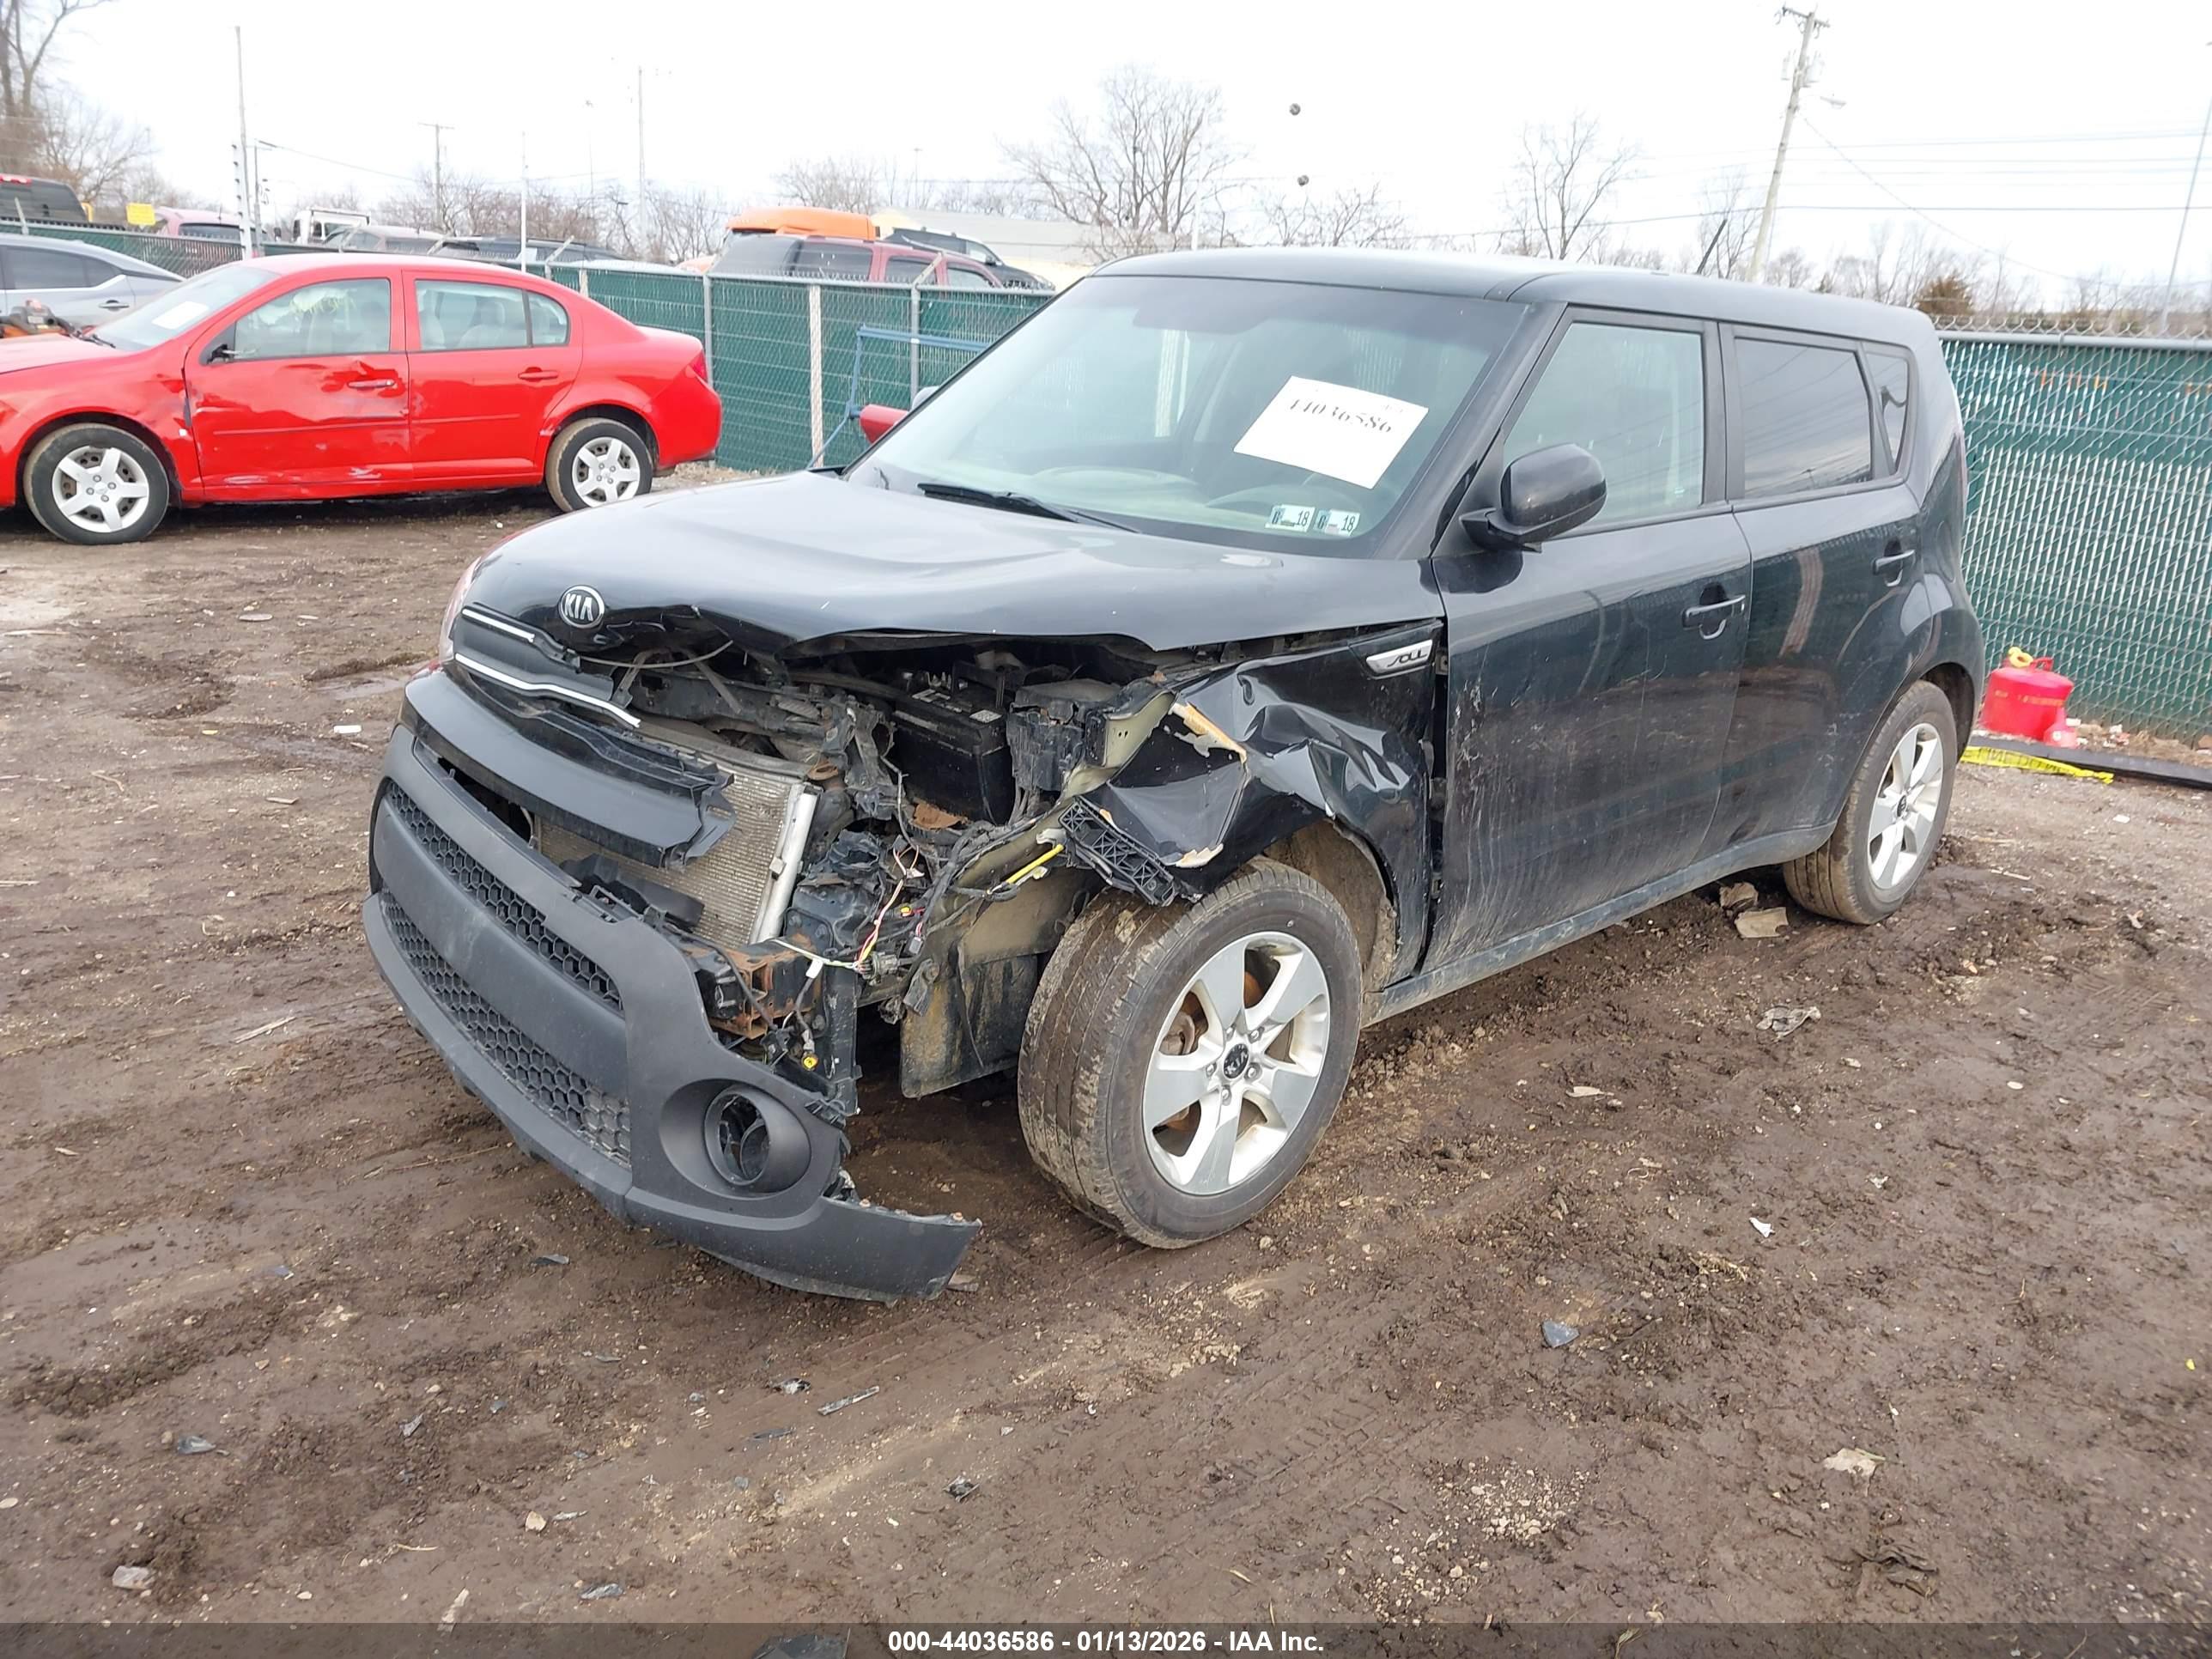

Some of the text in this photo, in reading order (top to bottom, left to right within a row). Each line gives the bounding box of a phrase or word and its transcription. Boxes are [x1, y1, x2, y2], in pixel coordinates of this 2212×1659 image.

[1297, 510, 1310, 526] 18
[1340, 515, 1356, 532] 18
[564, 592, 593, 622] KIA
